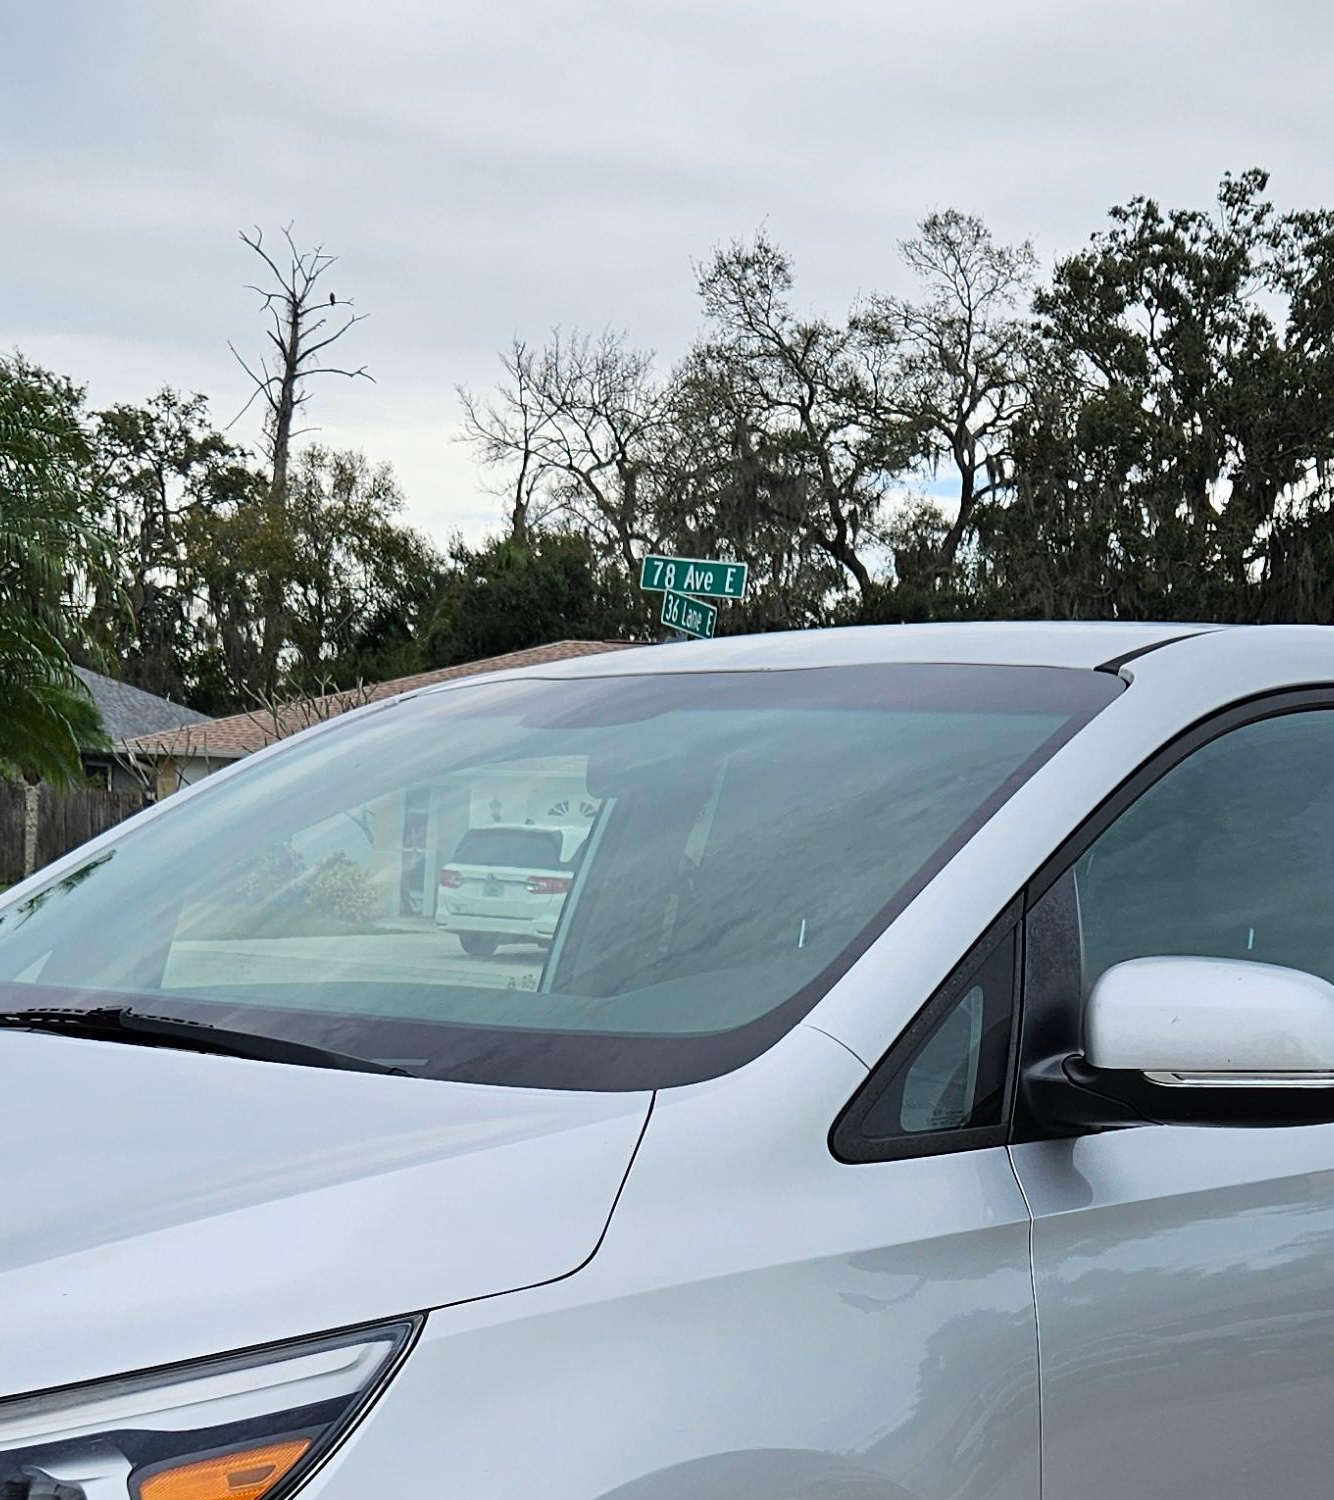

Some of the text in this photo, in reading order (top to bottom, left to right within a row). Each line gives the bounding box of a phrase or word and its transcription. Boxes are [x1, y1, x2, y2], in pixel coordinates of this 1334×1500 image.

[653, 561, 737, 593] 78 Ave E
[666, 594, 714, 636] 36 Lane E
